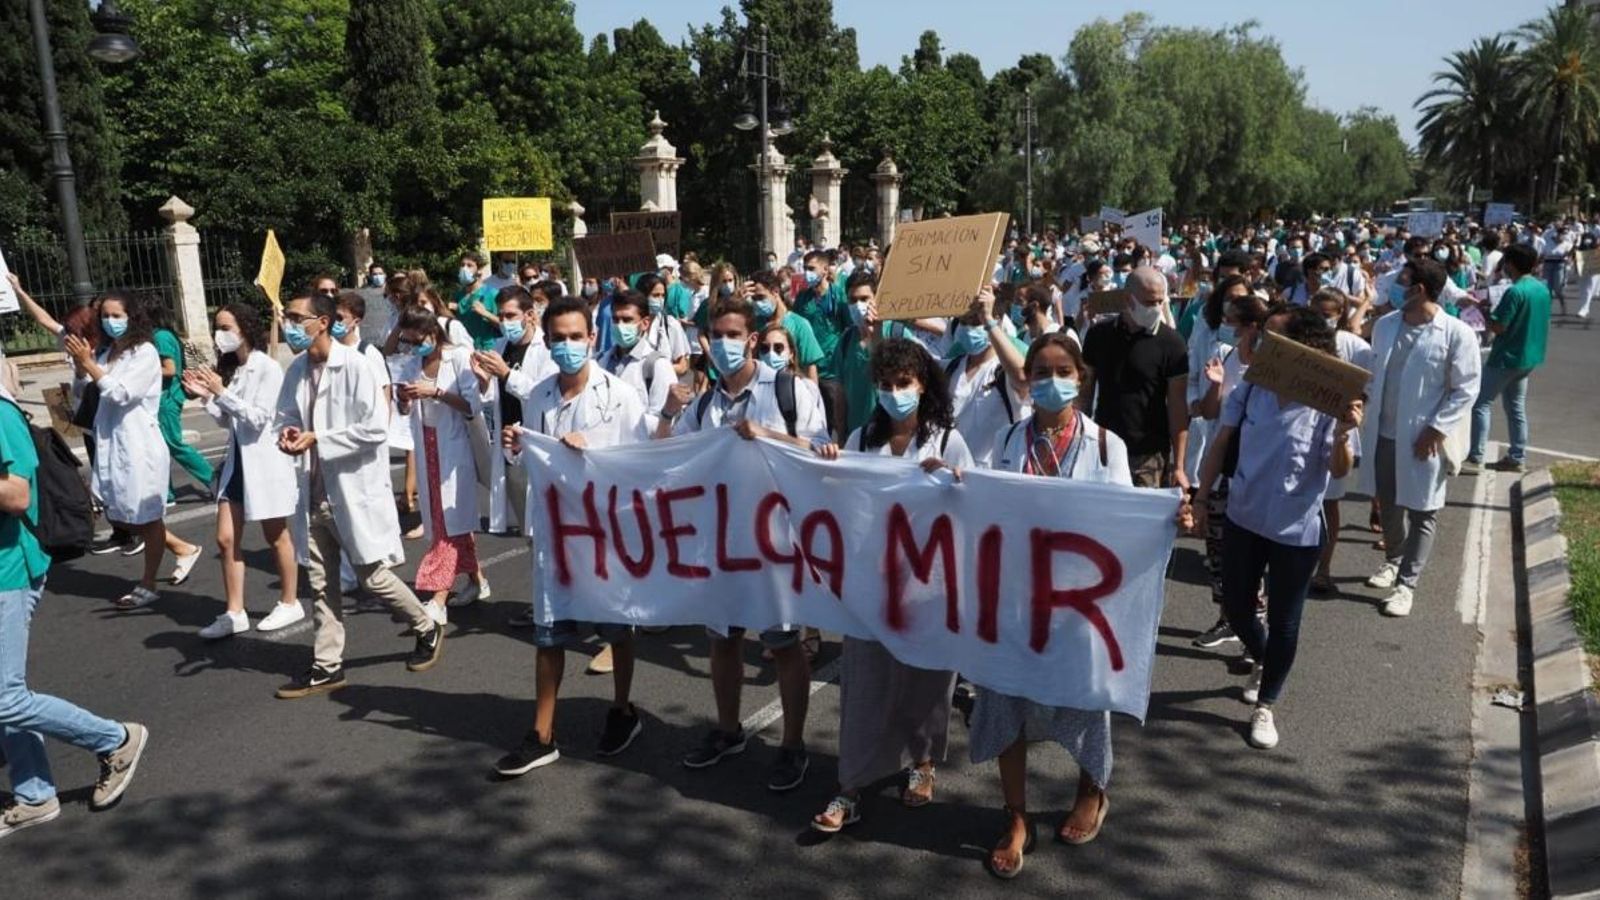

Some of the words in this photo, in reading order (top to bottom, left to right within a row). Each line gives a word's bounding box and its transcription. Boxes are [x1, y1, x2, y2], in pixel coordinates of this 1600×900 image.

[615, 213, 677, 232] APLAUDE
[906, 252, 953, 276] SIN
[545, 480, 846, 600] HUELGA
[882, 501, 1126, 673] MIR
